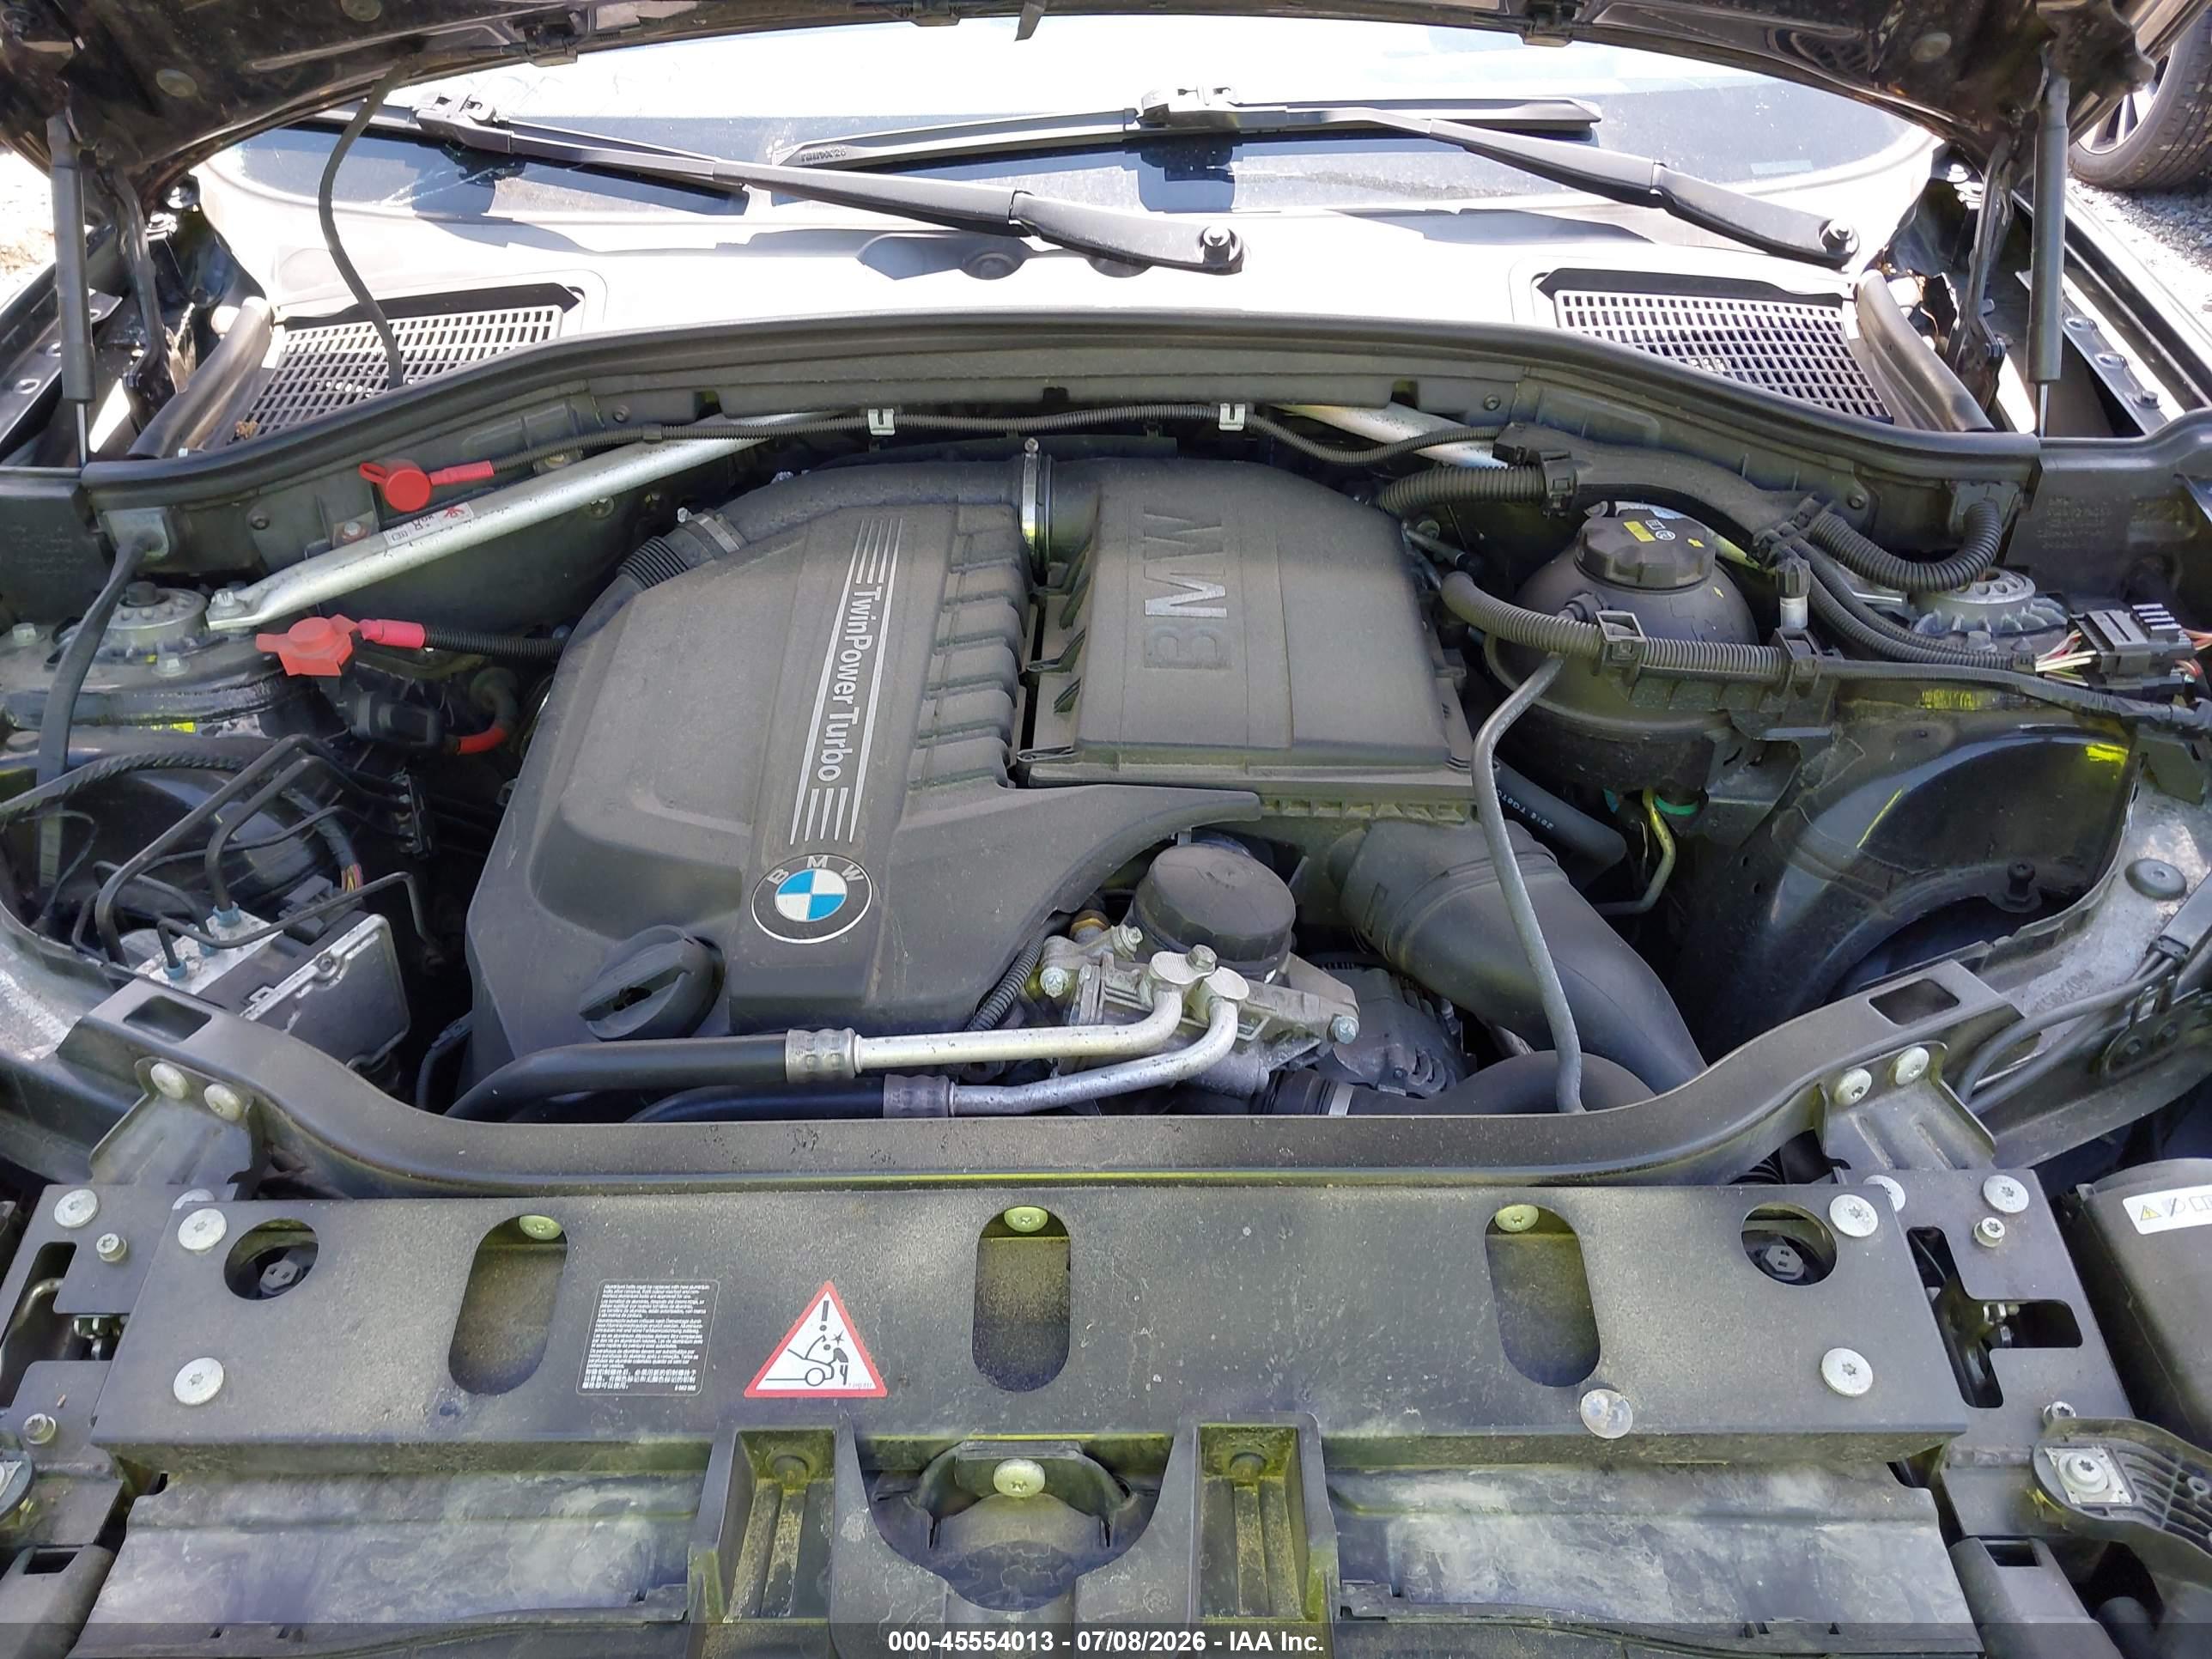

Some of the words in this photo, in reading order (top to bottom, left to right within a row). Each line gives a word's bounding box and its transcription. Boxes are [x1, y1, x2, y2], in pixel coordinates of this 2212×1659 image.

[1144, 505, 1230, 670] BMW
[832, 586, 882, 704] TwinPower
[817, 707, 860, 781] Turbo
[767, 855, 865, 885] BMW
